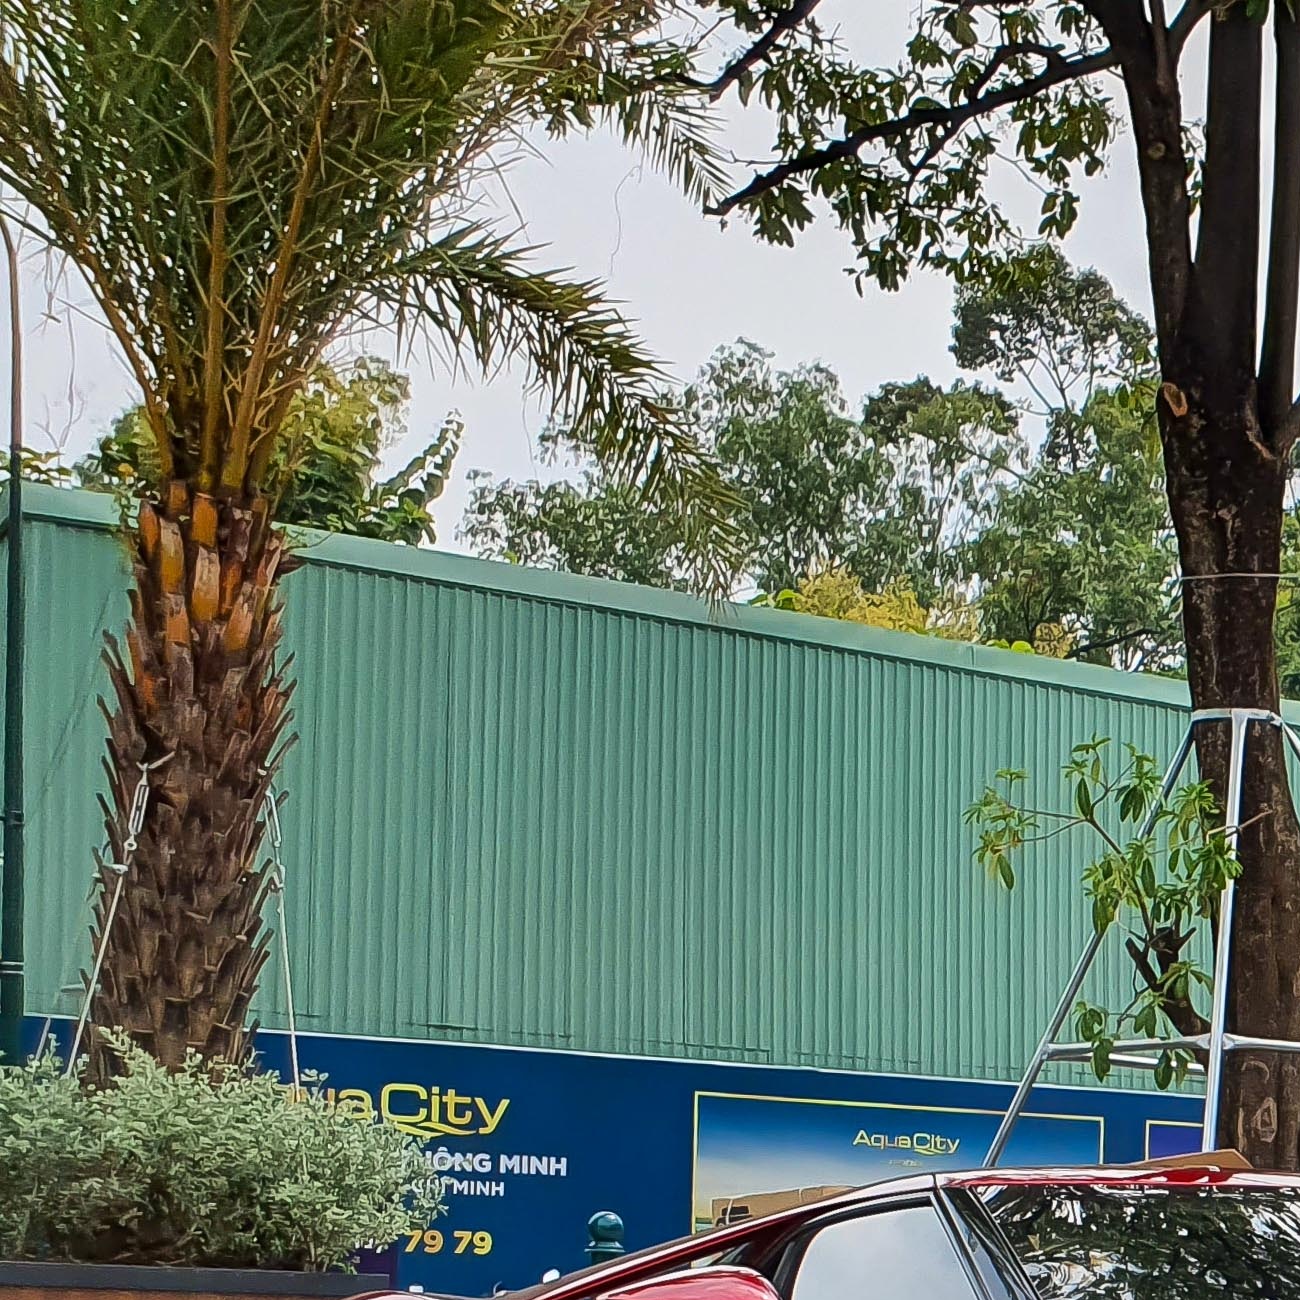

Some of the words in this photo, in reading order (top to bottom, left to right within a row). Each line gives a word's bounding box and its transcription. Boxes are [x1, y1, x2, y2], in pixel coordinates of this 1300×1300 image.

[499, 1154, 568, 1176] MINH
[453, 1180, 505, 1197] MINH
[404, 1229, 444, 1254] 79
[453, 1230, 493, 1255] 79
